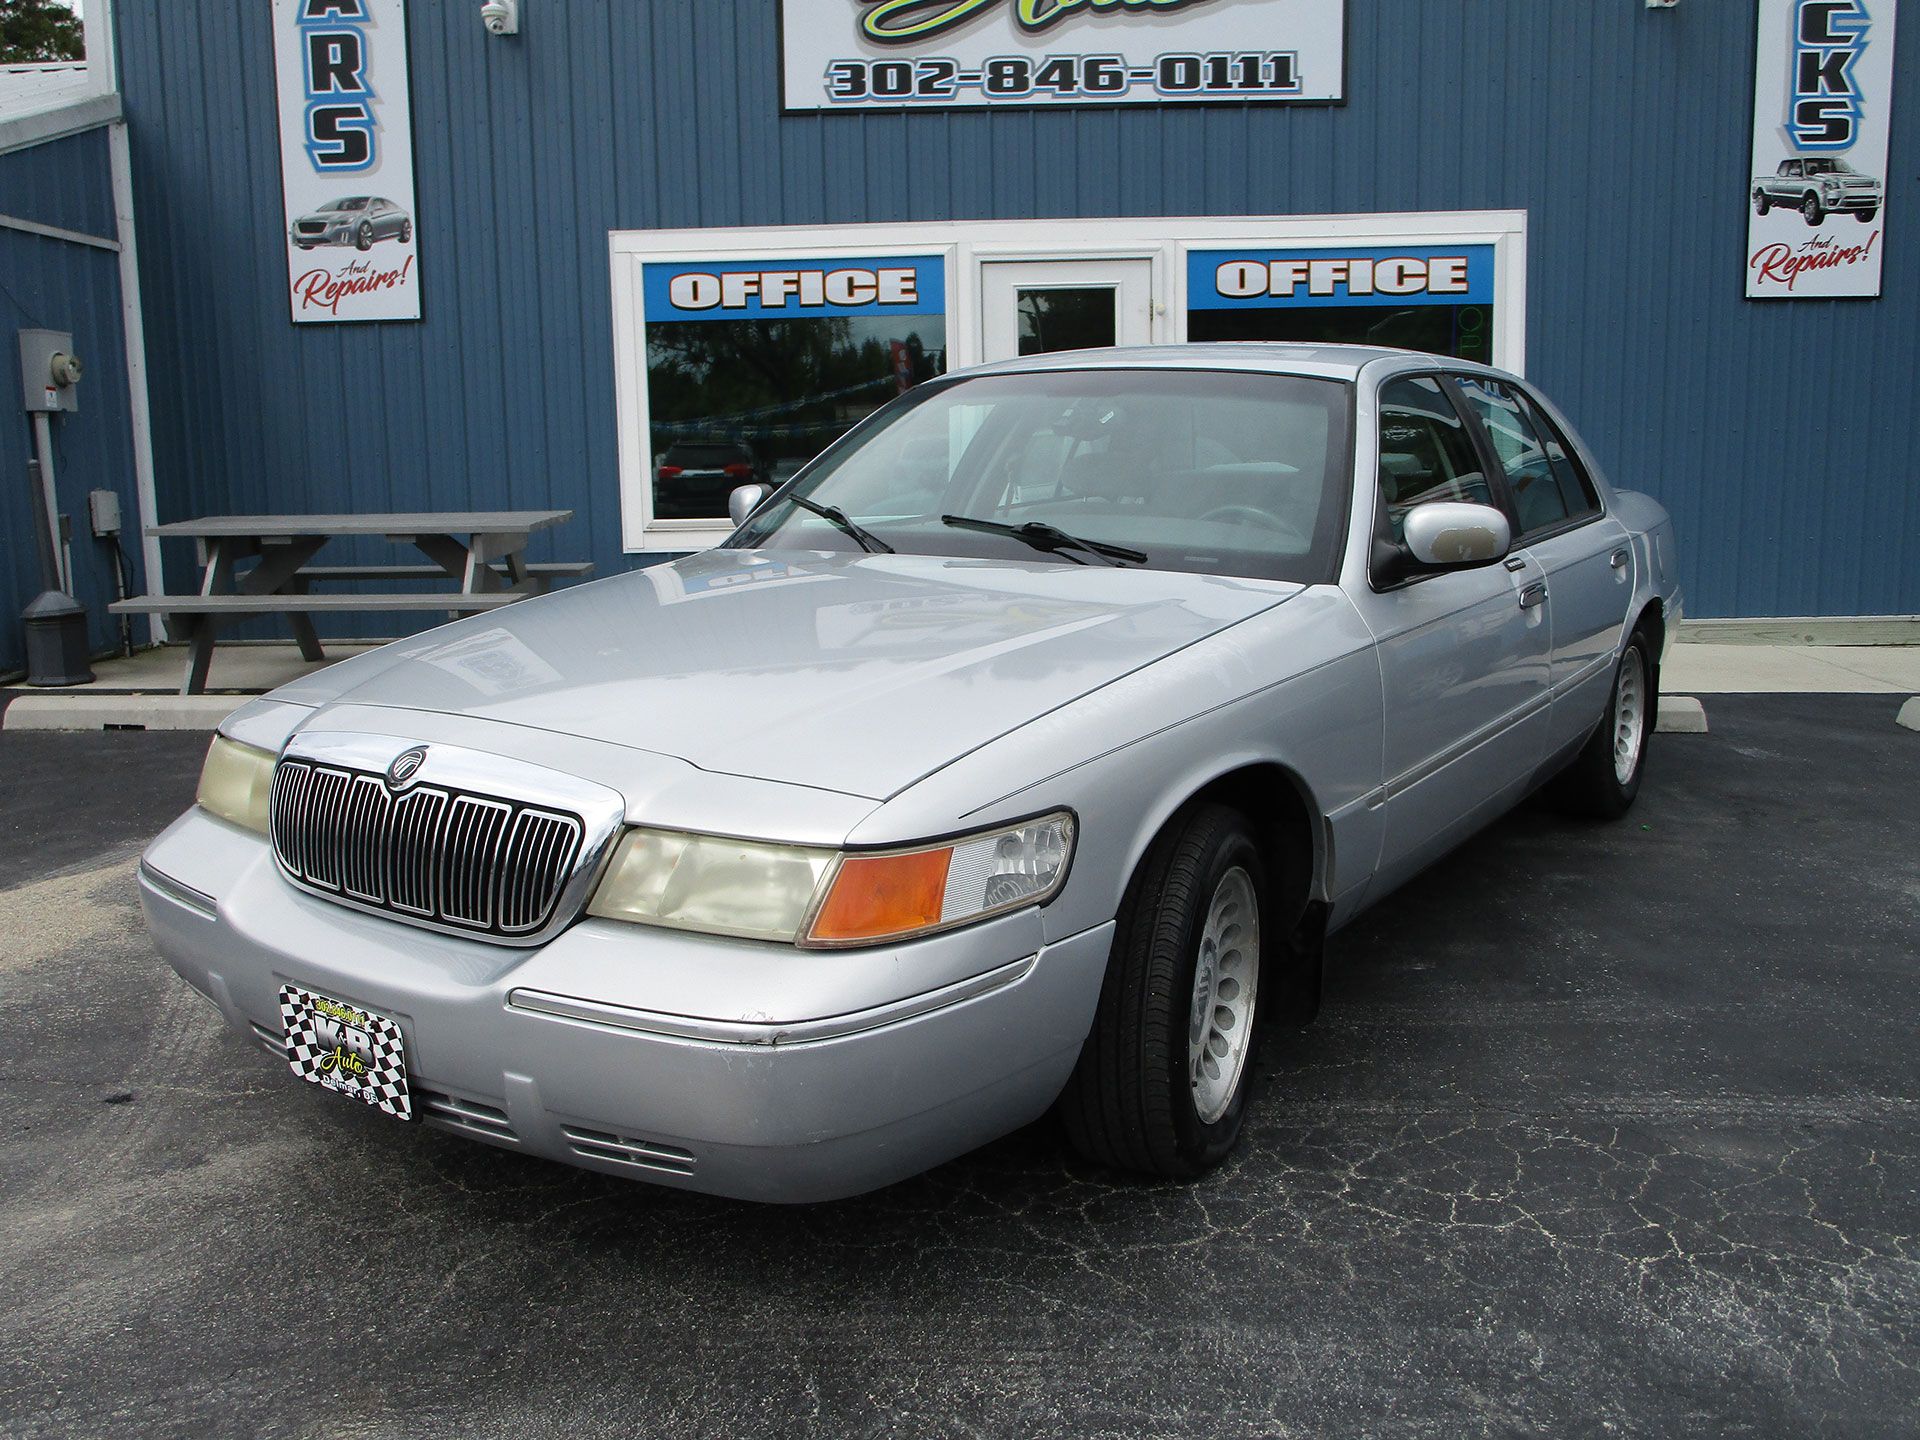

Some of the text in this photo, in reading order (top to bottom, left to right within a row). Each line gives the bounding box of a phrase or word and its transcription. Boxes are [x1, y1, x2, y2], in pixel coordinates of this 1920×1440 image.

[825, 51, 1302, 101] 302-846-0111
[1750, 230, 1879, 291] Repairs!
[1798, 234, 1833, 252] And
[293, 255, 414, 315] Repairs!
[337, 259, 370, 277] And
[669, 267, 918, 311] OFFICE
[1216, 256, 1469, 299] OFFICE
[320, 1047, 366, 1074] Auto
